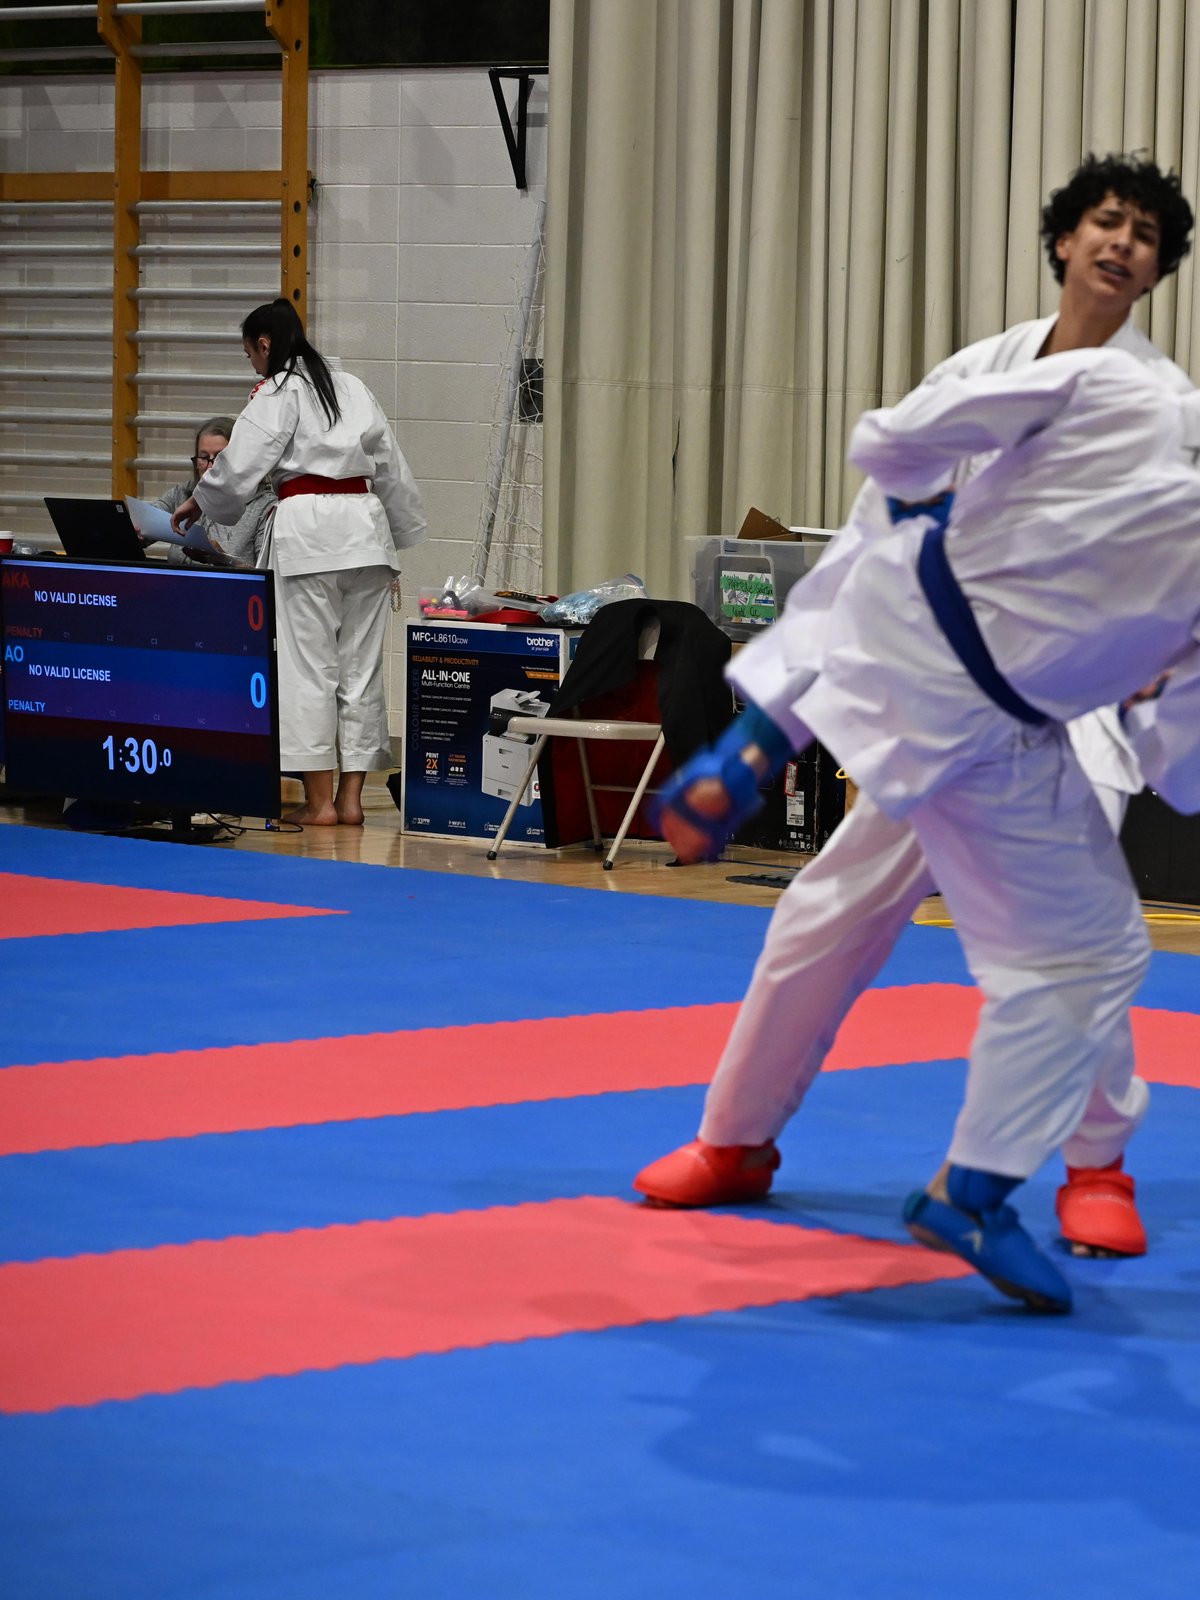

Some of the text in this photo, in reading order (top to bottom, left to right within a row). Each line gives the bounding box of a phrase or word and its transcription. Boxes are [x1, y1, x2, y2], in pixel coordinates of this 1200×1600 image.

[2, 572, 30, 588] AKA
[34, 590, 117, 607] NO VALID LICENSE
[248, 594, 264, 631] 0
[5, 625, 43, 638] PENALTY
[526, 636, 554, 647] brother
[4, 645, 24, 662] AO
[28, 664, 111, 682] NO VALID LICENSE
[421, 669, 471, 683] ALL-IN-ONE
[250, 672, 266, 709] 0
[421, 680, 454, 689] Multi-Function
[8, 700, 46, 712] PENALTY
[426, 758, 438, 770] 2X
